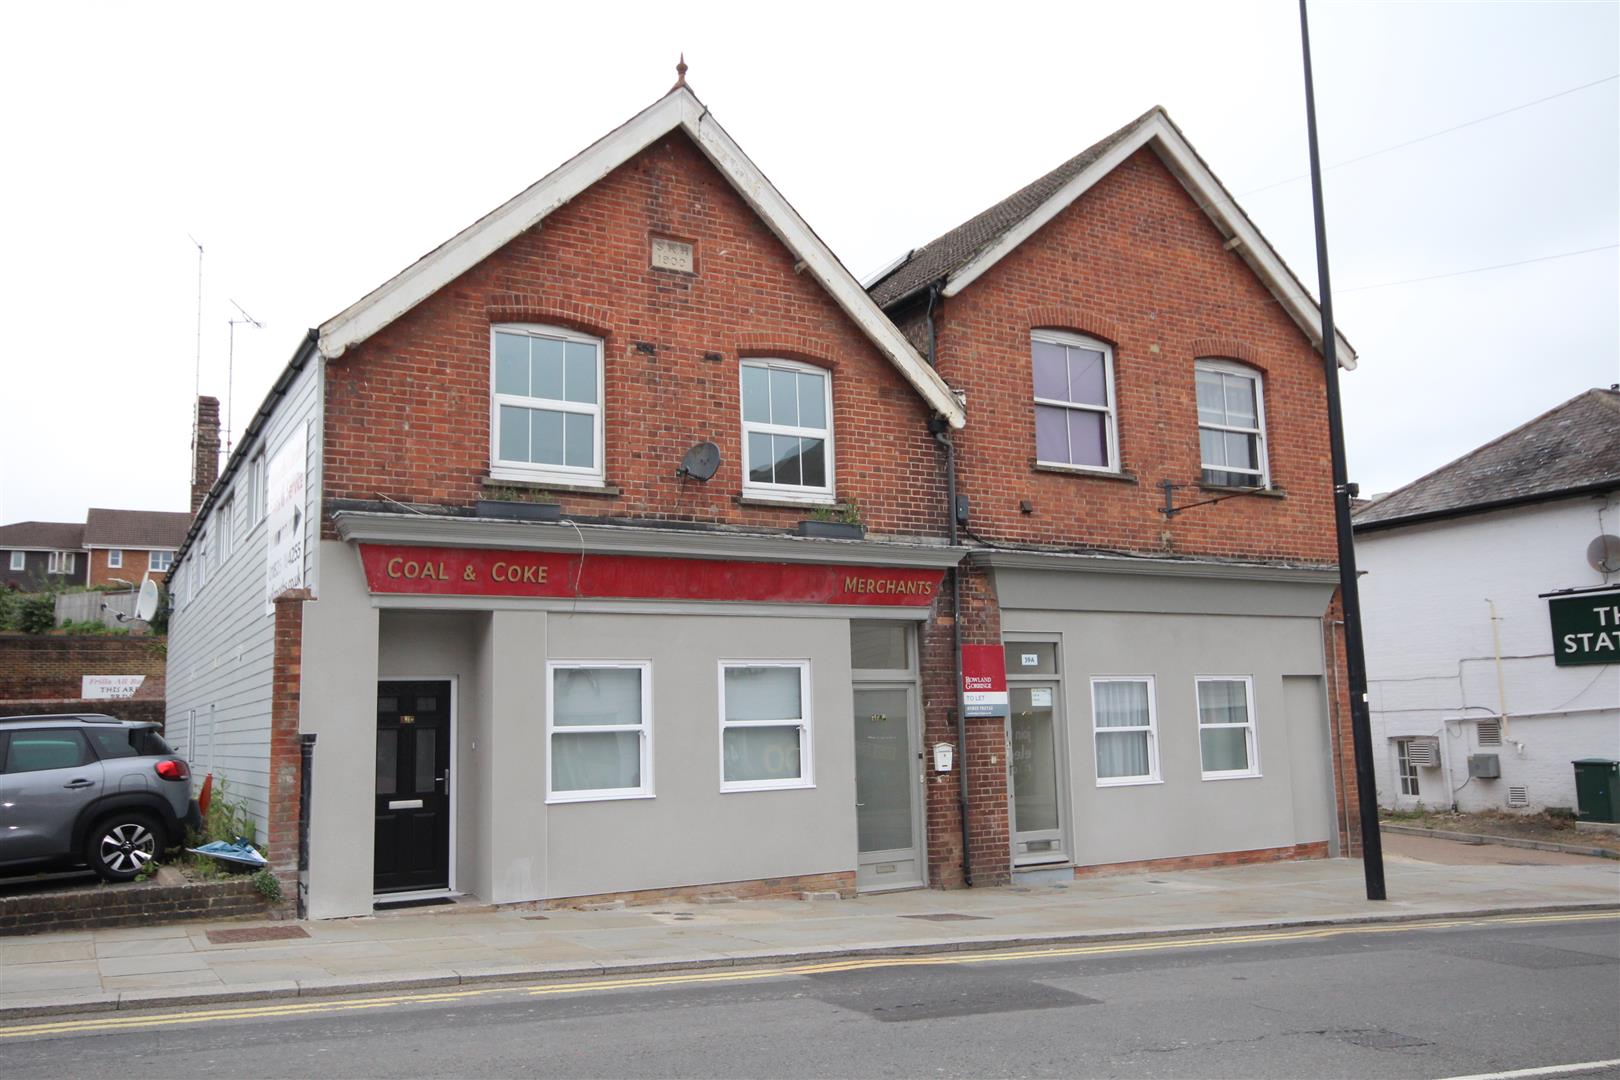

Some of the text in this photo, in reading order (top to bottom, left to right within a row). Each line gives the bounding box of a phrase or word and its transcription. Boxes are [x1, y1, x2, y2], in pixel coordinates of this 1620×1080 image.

[387, 557, 549, 584] COAL & COKE
[844, 575, 933, 595] MERCHANTS
